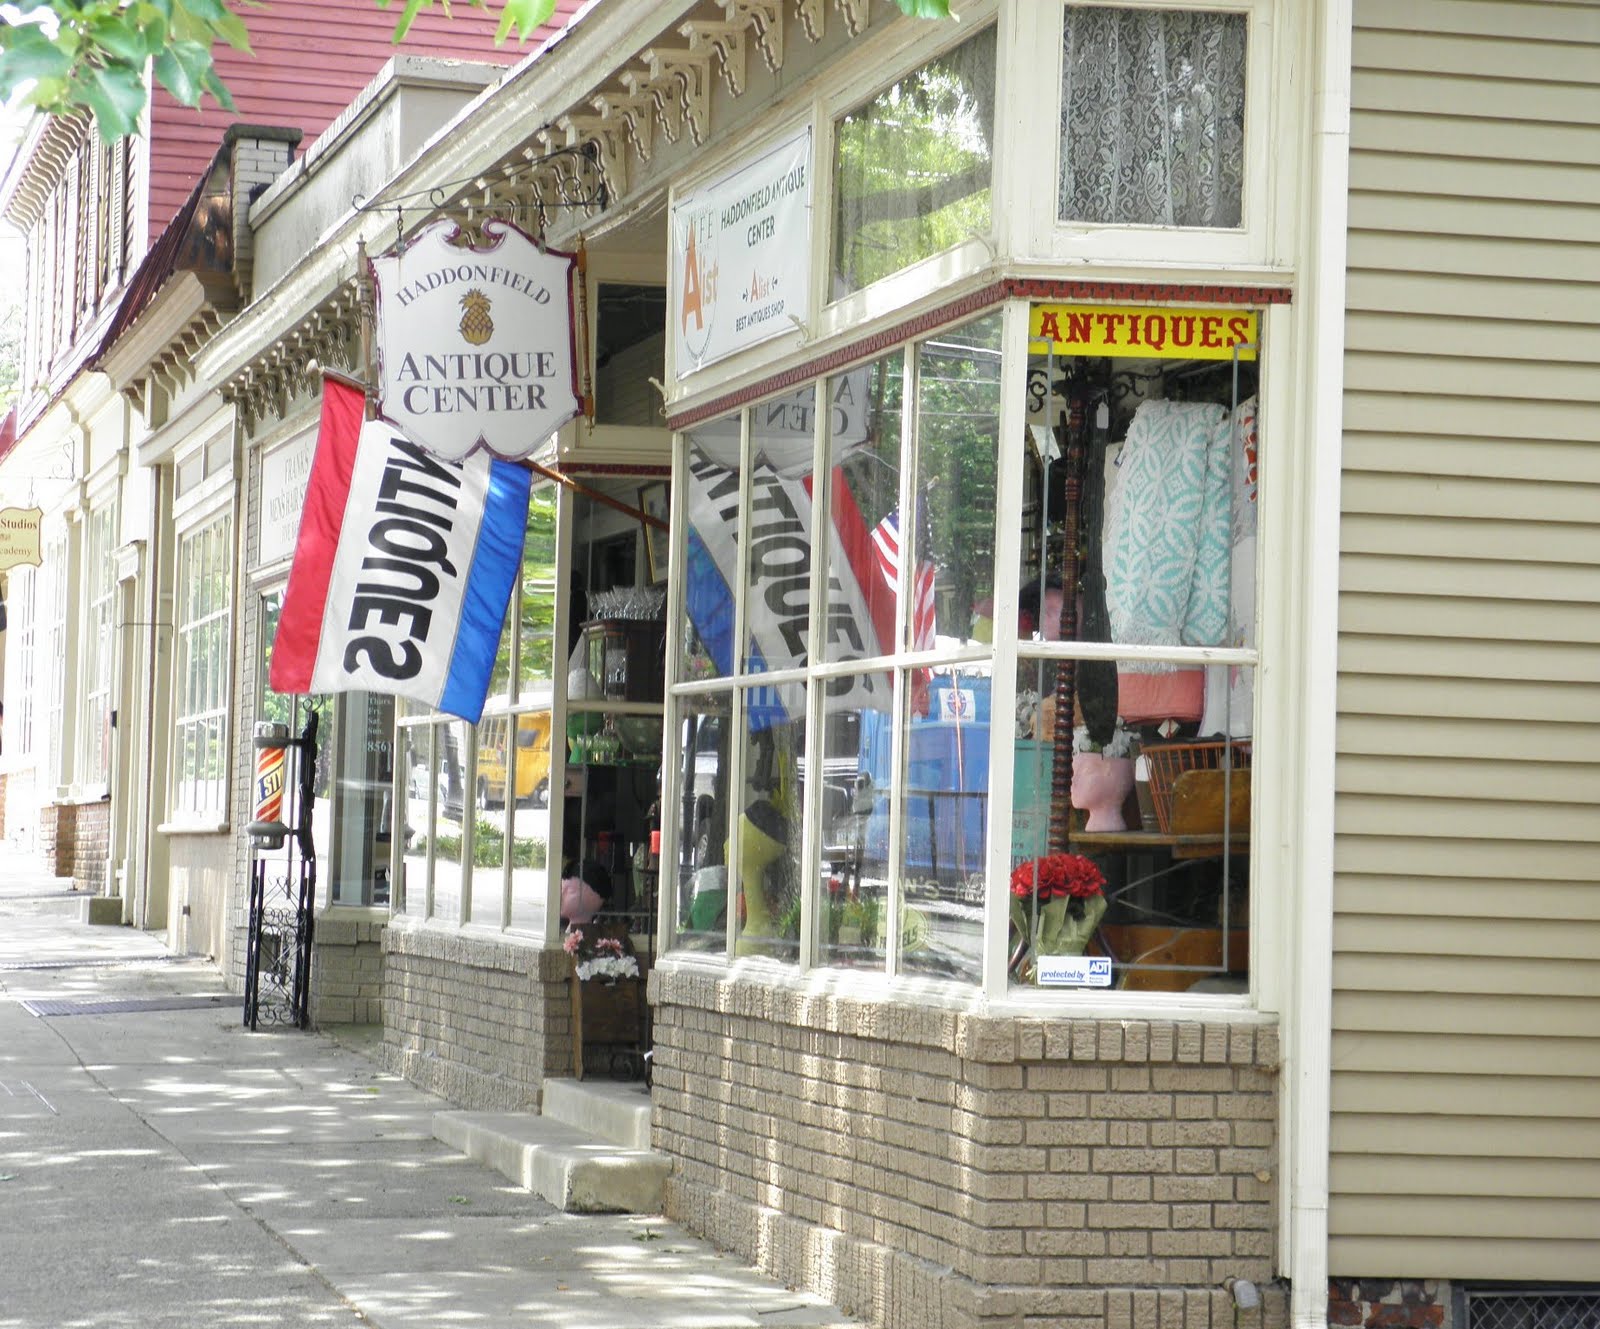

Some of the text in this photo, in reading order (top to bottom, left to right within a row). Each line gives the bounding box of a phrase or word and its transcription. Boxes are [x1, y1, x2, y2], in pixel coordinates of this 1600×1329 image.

[721, 185, 770, 231] HADDONFIELD
[771, 165, 804, 203] ANTIQUE
[747, 215, 775, 248] CENTER
[396, 264, 551, 307] HADDONFIELD
[736, 299, 785, 332] BEST ANTIQUES SHOP
[1040, 311, 1249, 351] ANTIQUES
[396, 351, 557, 384] ANTIQUE
[403, 383, 548, 415] CENTER
[0, 518, 37, 529] Studios
[0, 546, 31, 557] cademy
[1040, 969, 1085, 980] protected by
[1090, 960, 1108, 974] ADT
